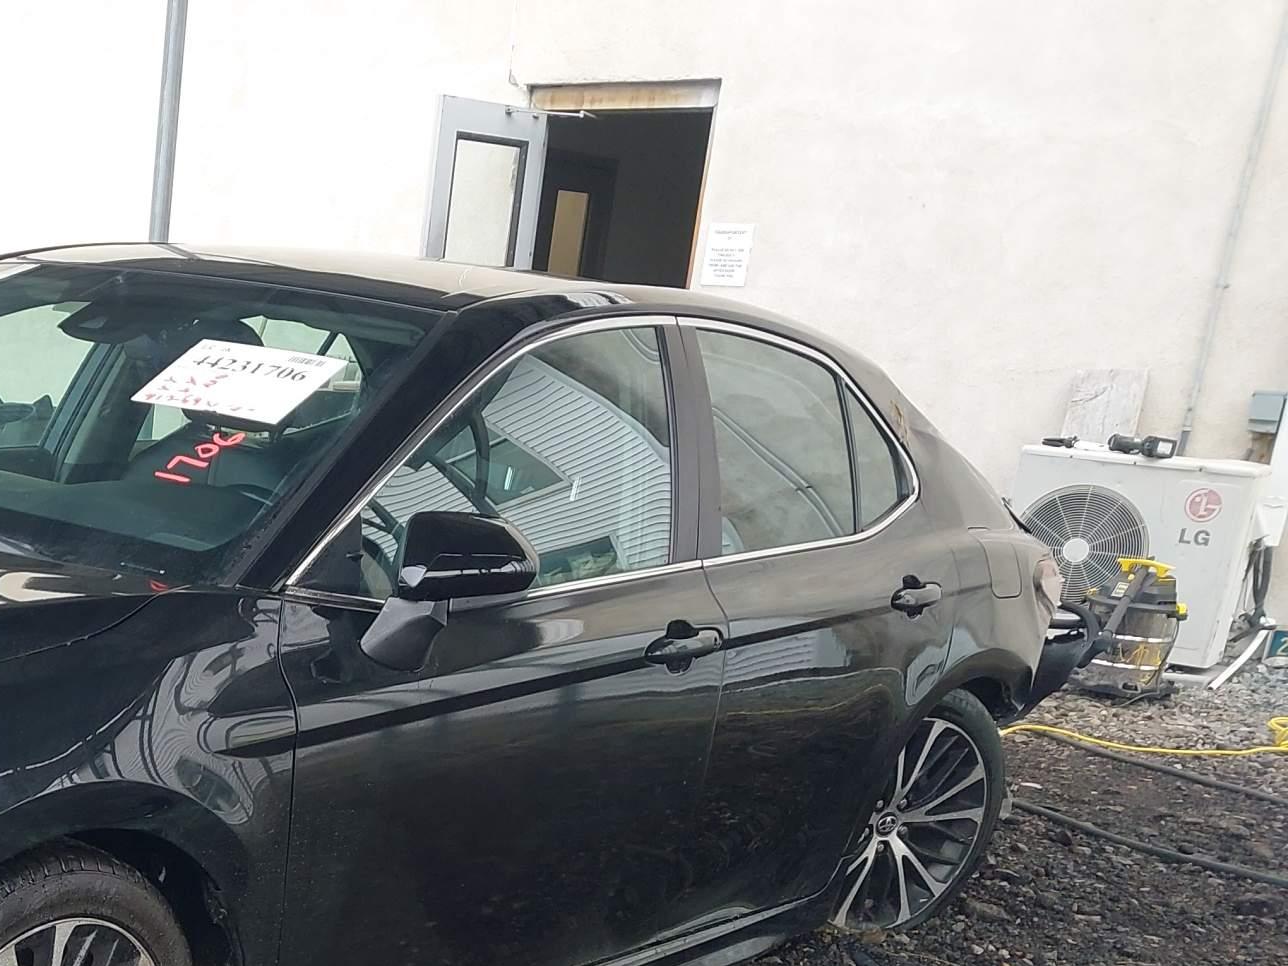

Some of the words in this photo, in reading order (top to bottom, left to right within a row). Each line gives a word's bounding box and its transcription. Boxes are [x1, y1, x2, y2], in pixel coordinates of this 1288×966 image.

[193, 354, 307, 383] 44231706
[154, 431, 246, 483] 1706
[1178, 528, 1211, 546] LG
